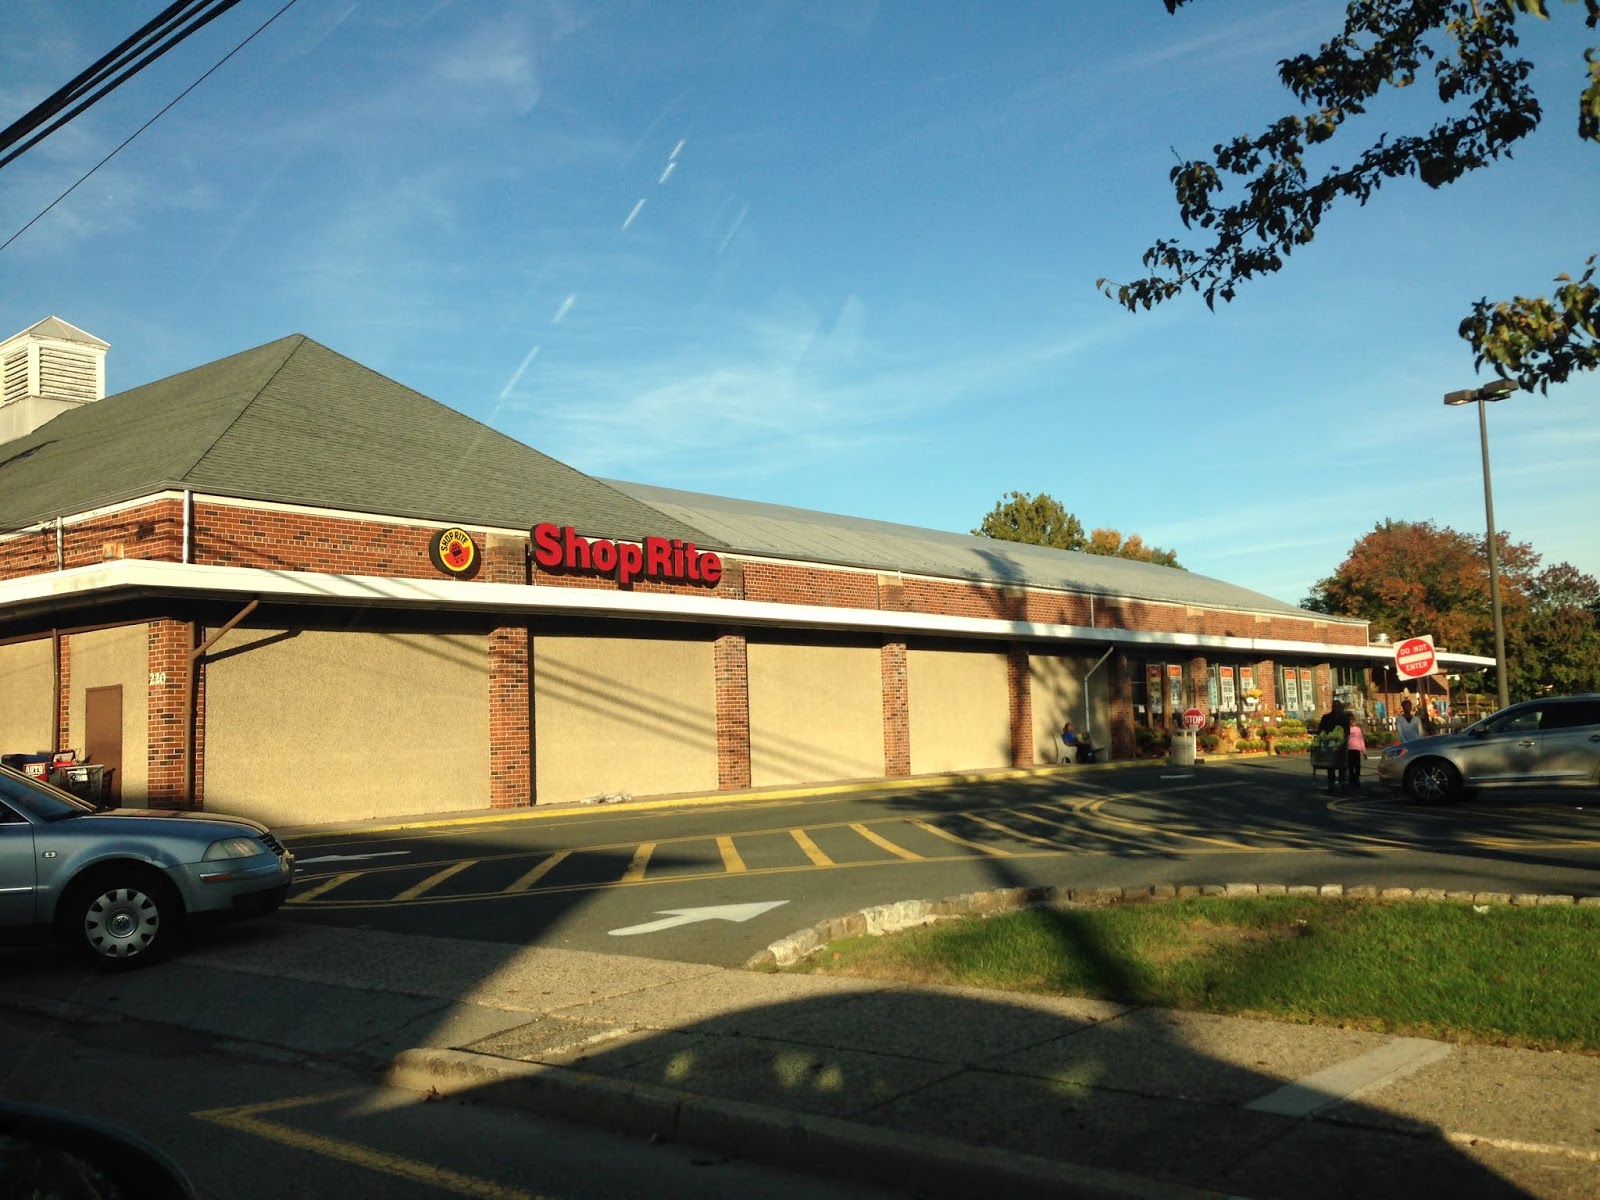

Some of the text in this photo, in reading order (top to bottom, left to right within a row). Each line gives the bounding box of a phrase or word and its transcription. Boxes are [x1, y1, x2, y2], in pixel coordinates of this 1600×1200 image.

[1400, 643, 1428, 656] DO NOT
[1405, 660, 1429, 672] ENTER
[1184, 715, 1203, 725] STOP
